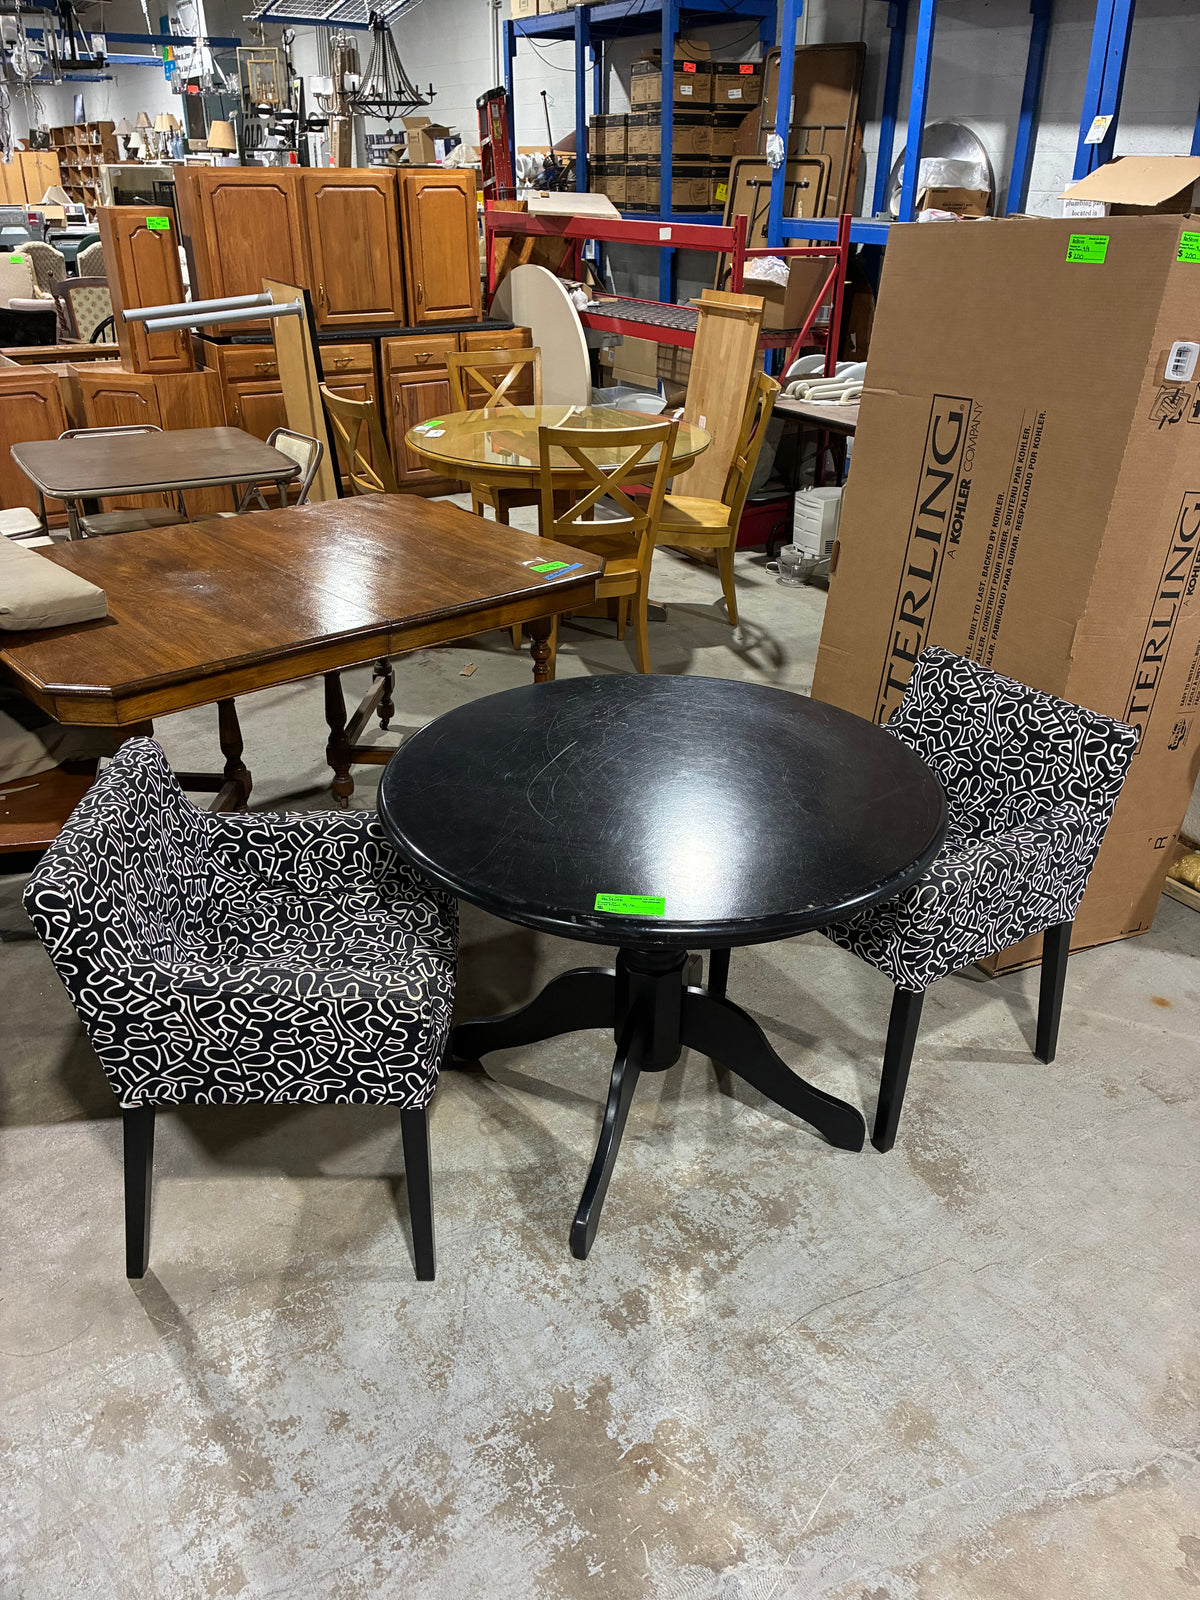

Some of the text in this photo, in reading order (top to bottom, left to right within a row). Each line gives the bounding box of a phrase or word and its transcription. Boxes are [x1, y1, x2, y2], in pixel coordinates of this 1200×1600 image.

[946, 401, 983, 560] A KOHLER COMPANY
[975, 425, 1031, 662] ALLER. CONSTRUIT POUR DURER. SOUTENU PAR KOHLER.
[985, 410, 1047, 667] ALAR. FABRICADO PARA DURAR. RESPALDADO POR KOHLER.
[964, 491, 1005, 659] ALL. BUILT TO LAST. BACKED BY KOHLER.
[1180, 692, 1188, 706] EASY
